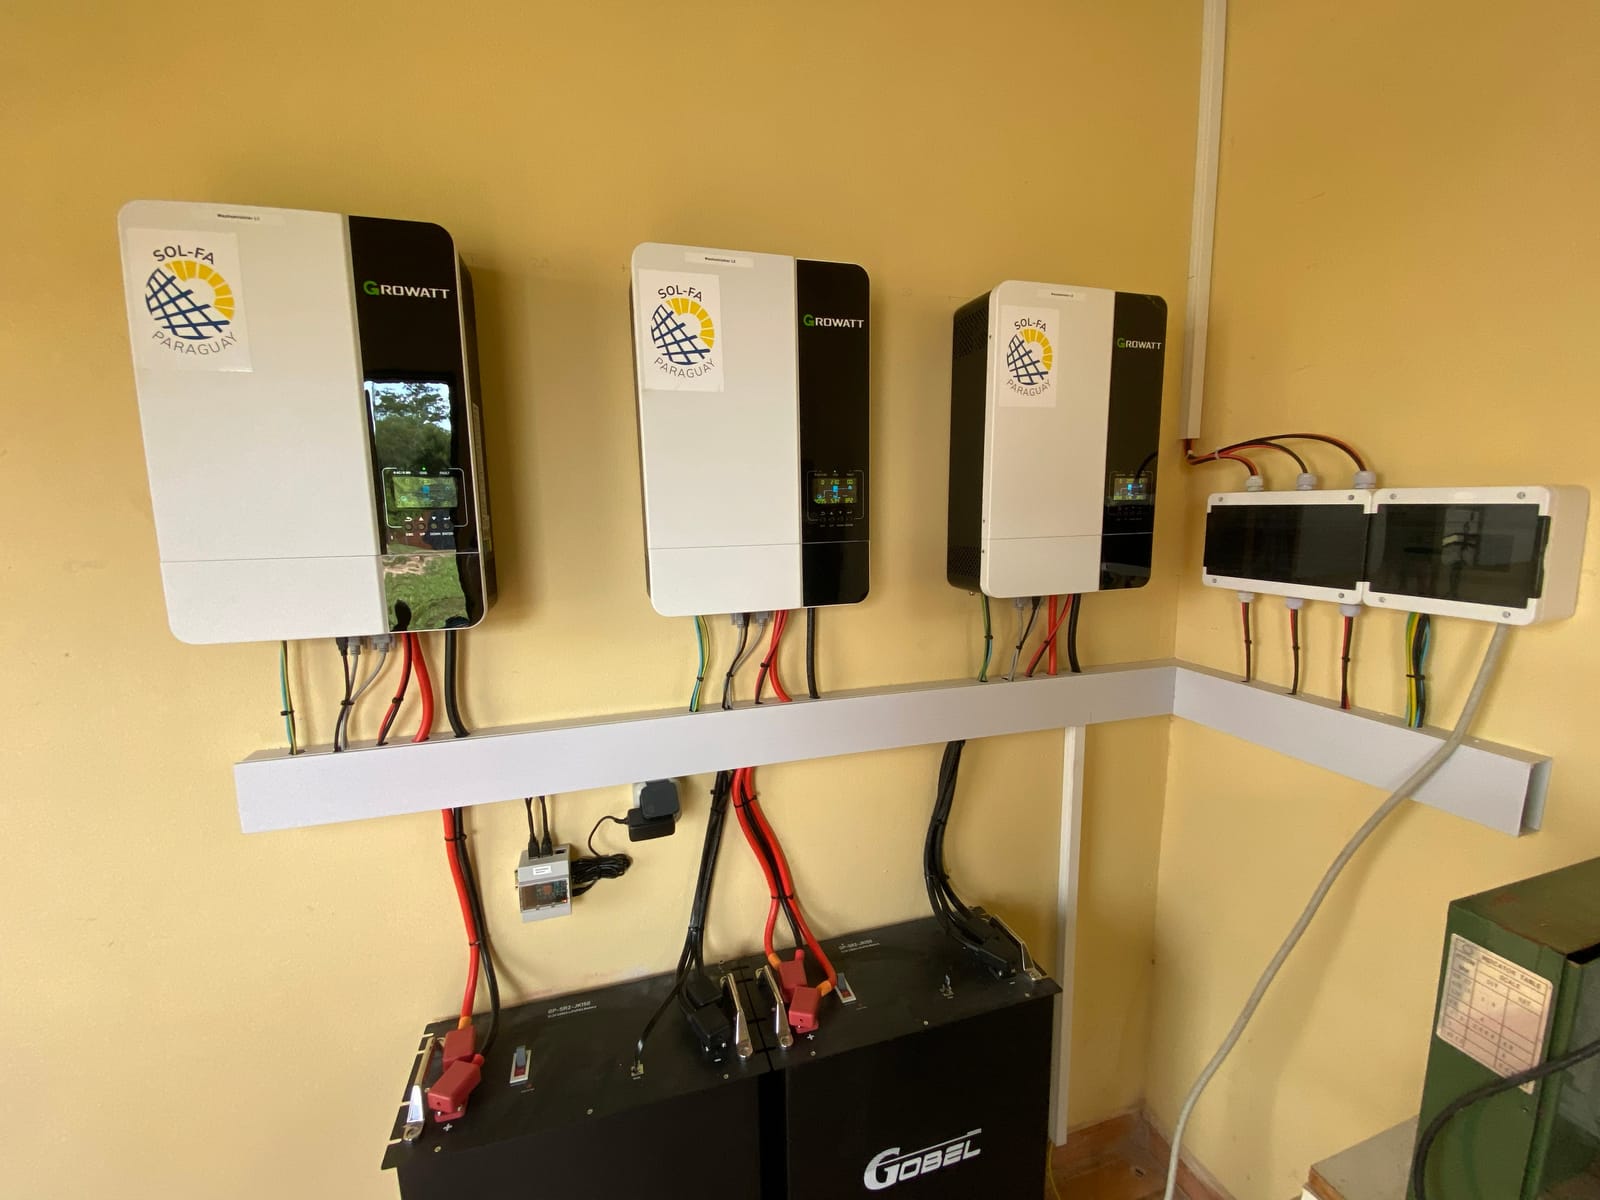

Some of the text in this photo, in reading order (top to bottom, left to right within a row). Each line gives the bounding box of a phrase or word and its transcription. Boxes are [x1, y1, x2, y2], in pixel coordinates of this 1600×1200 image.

[153, 245, 215, 265] SOL-FA
[363, 281, 450, 299] GROWATT
[658, 284, 703, 302] SOL-FA
[803, 314, 864, 329] GROWATT
[1014, 317, 1047, 332] SOL-FA
[152, 331, 238, 356] PARAGUAY
[1117, 337, 1162, 350] GROWATT
[654, 357, 716, 379] PARAGUAY
[1006, 378, 1052, 397] PARAGUAY
[864, 1128, 982, 1190] GOBEL
